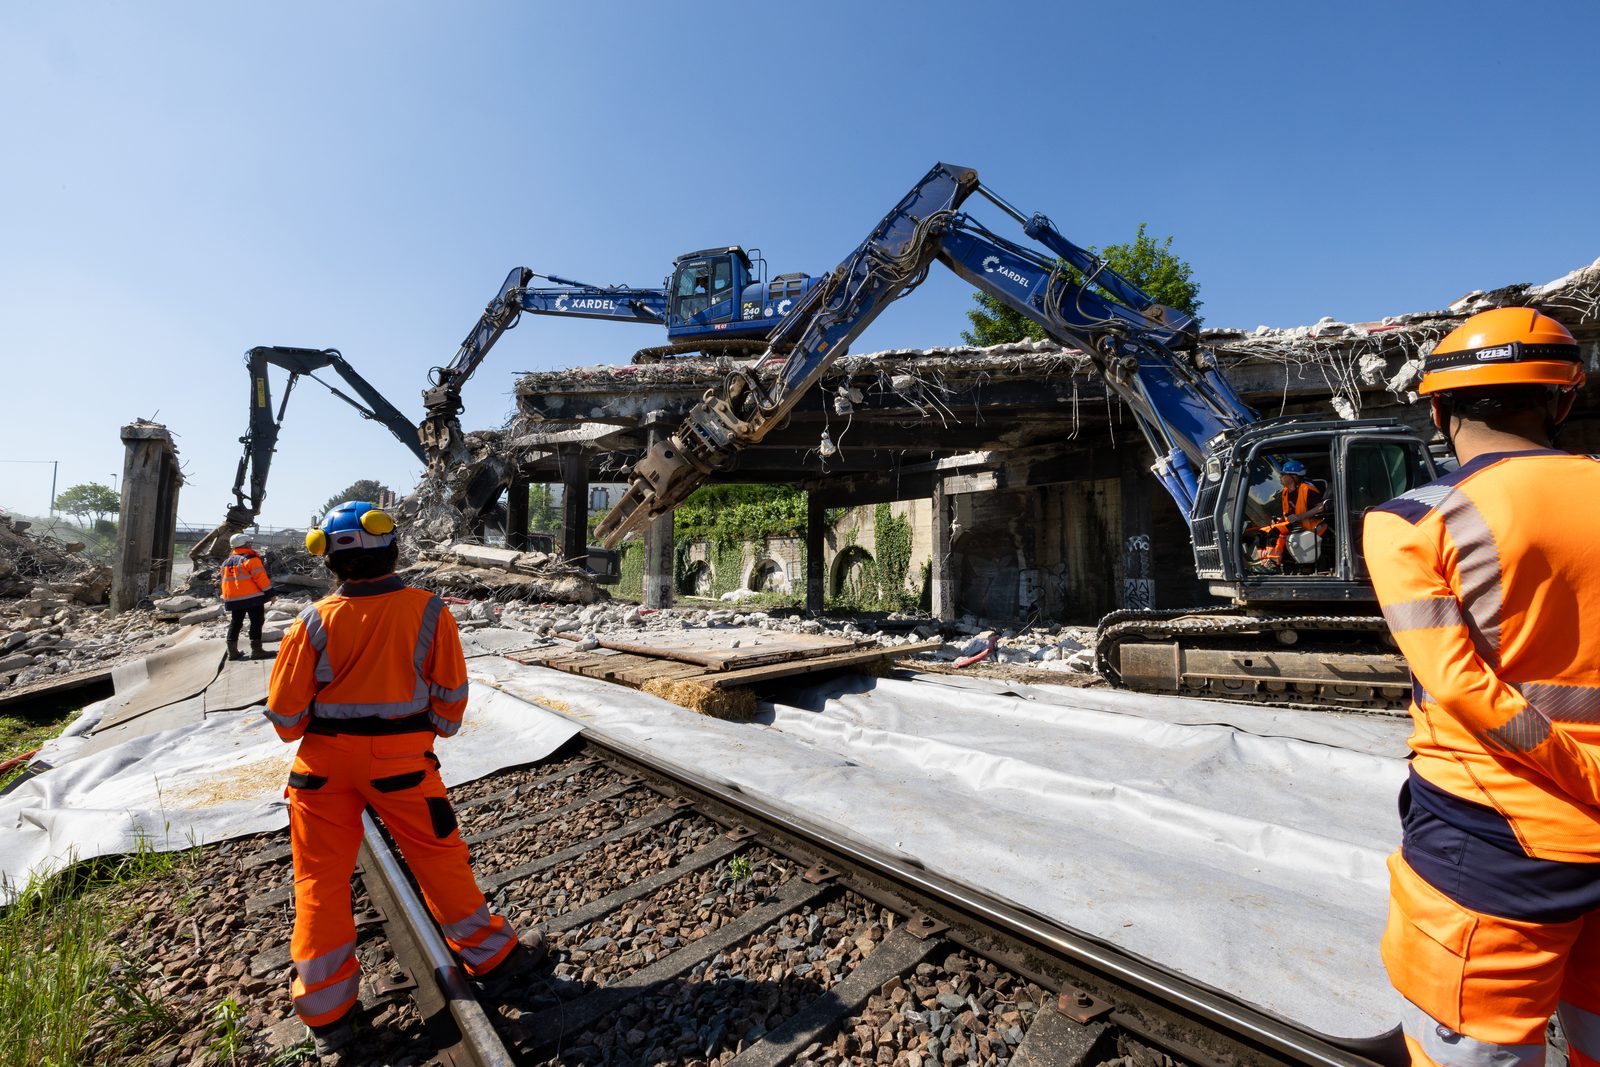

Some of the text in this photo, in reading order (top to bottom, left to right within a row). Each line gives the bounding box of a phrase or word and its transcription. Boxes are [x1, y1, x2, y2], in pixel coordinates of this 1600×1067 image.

[996, 265, 1029, 288] XARDEL
[571, 299, 615, 310] XARDEL
[743, 307, 760, 316] 240
[1475, 344, 1513, 359] PETZL
